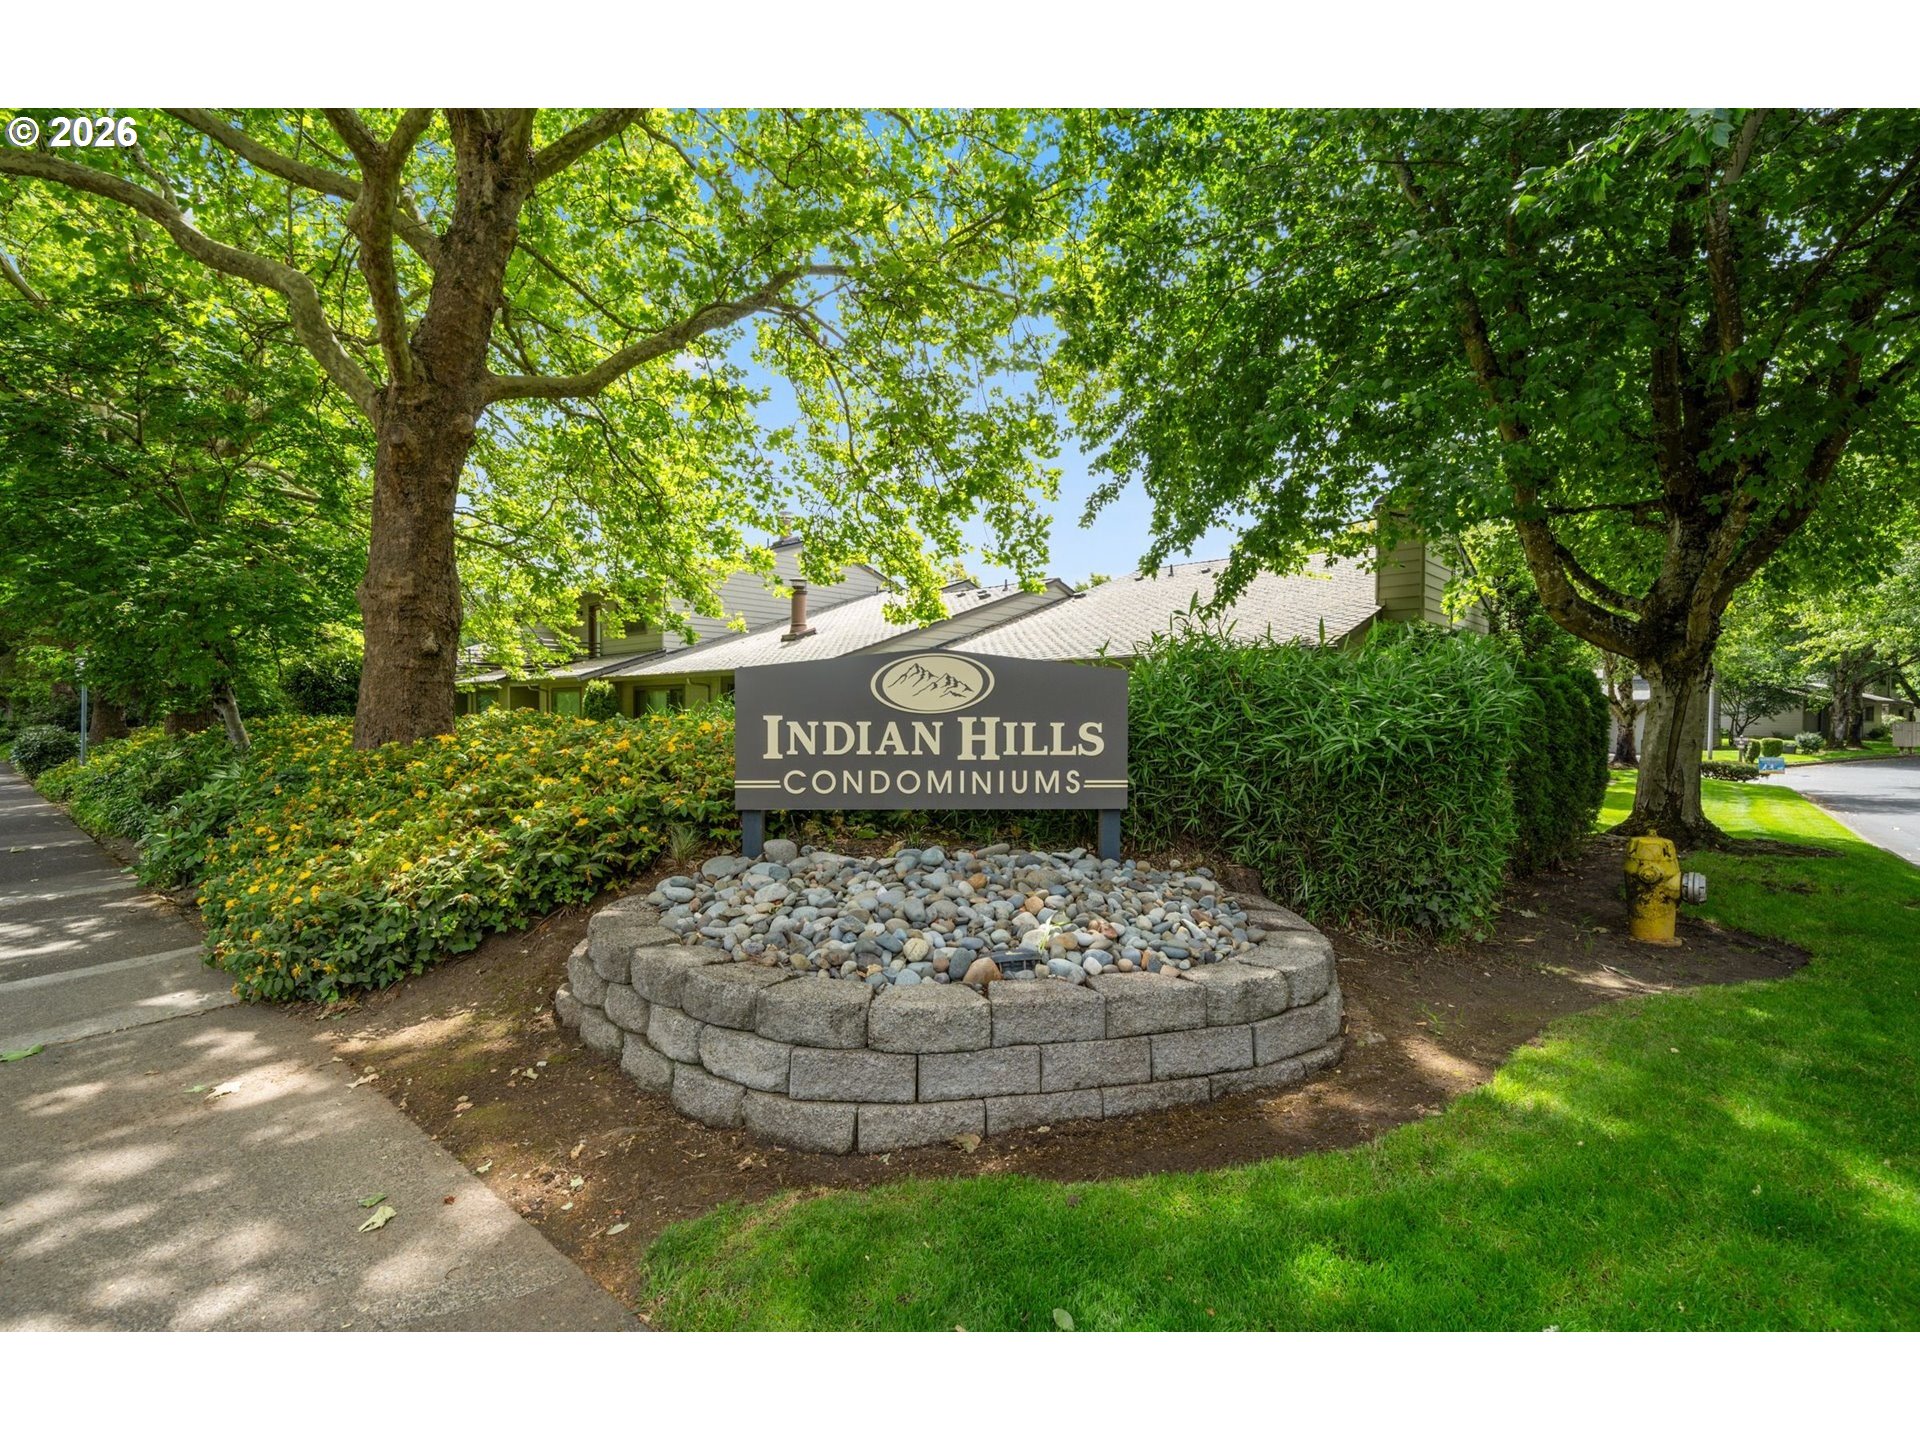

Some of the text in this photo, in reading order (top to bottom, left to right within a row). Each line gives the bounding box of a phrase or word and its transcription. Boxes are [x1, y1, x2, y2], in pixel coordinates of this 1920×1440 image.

[762, 714, 1105, 761] INDIAN HILLS
[783, 769, 1081, 795] CONDOMINIUMS
